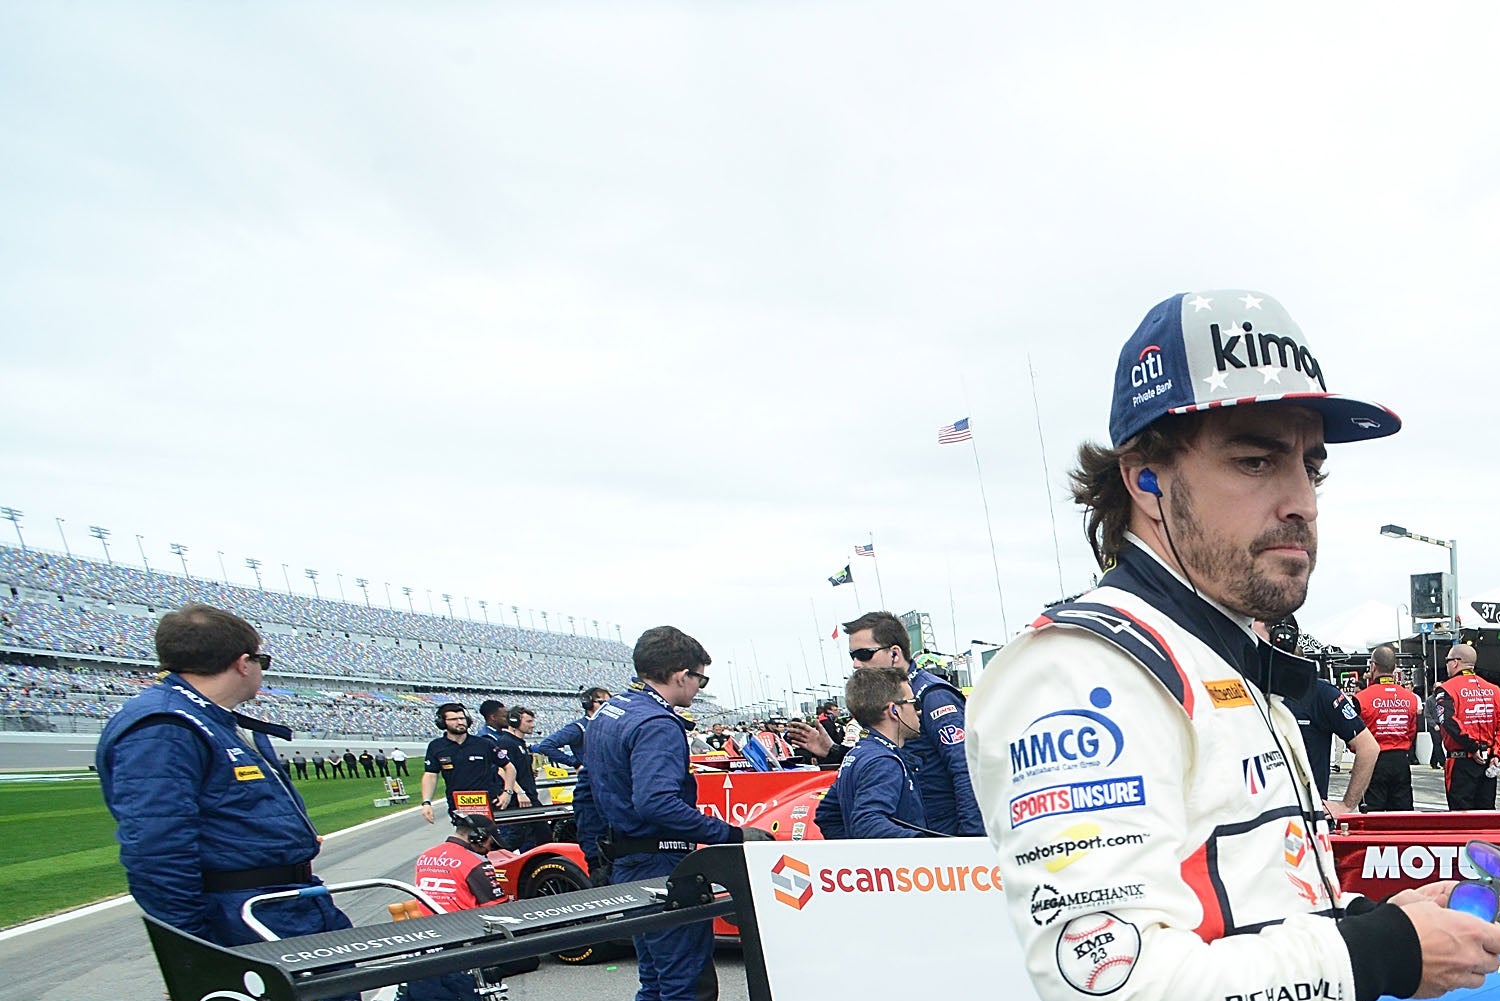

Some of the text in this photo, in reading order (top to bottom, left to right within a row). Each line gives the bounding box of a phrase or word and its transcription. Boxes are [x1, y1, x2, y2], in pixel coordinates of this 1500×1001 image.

[1131, 348, 1164, 387] citi
[1210, 322, 1327, 392] kimo
[1132, 379, 1173, 407] Private Bank
[1481, 603, 1496, 619] 37
[1372, 697, 1411, 709] GAINSCO
[730, 761, 754, 769] MOTU
[1010, 727, 1100, 774] MMCG
[1012, 781, 1141, 822] SPORTS INSURE
[1015, 834, 1144, 866] motorsport.com
[821, 864, 1003, 893] scansource
[523, 893, 637, 922] CROWDSTRIKE
[280, 928, 442, 965] CROWDSTRIKE
[1073, 931, 1115, 960] KMB
[1090, 947, 1108, 965] 23
